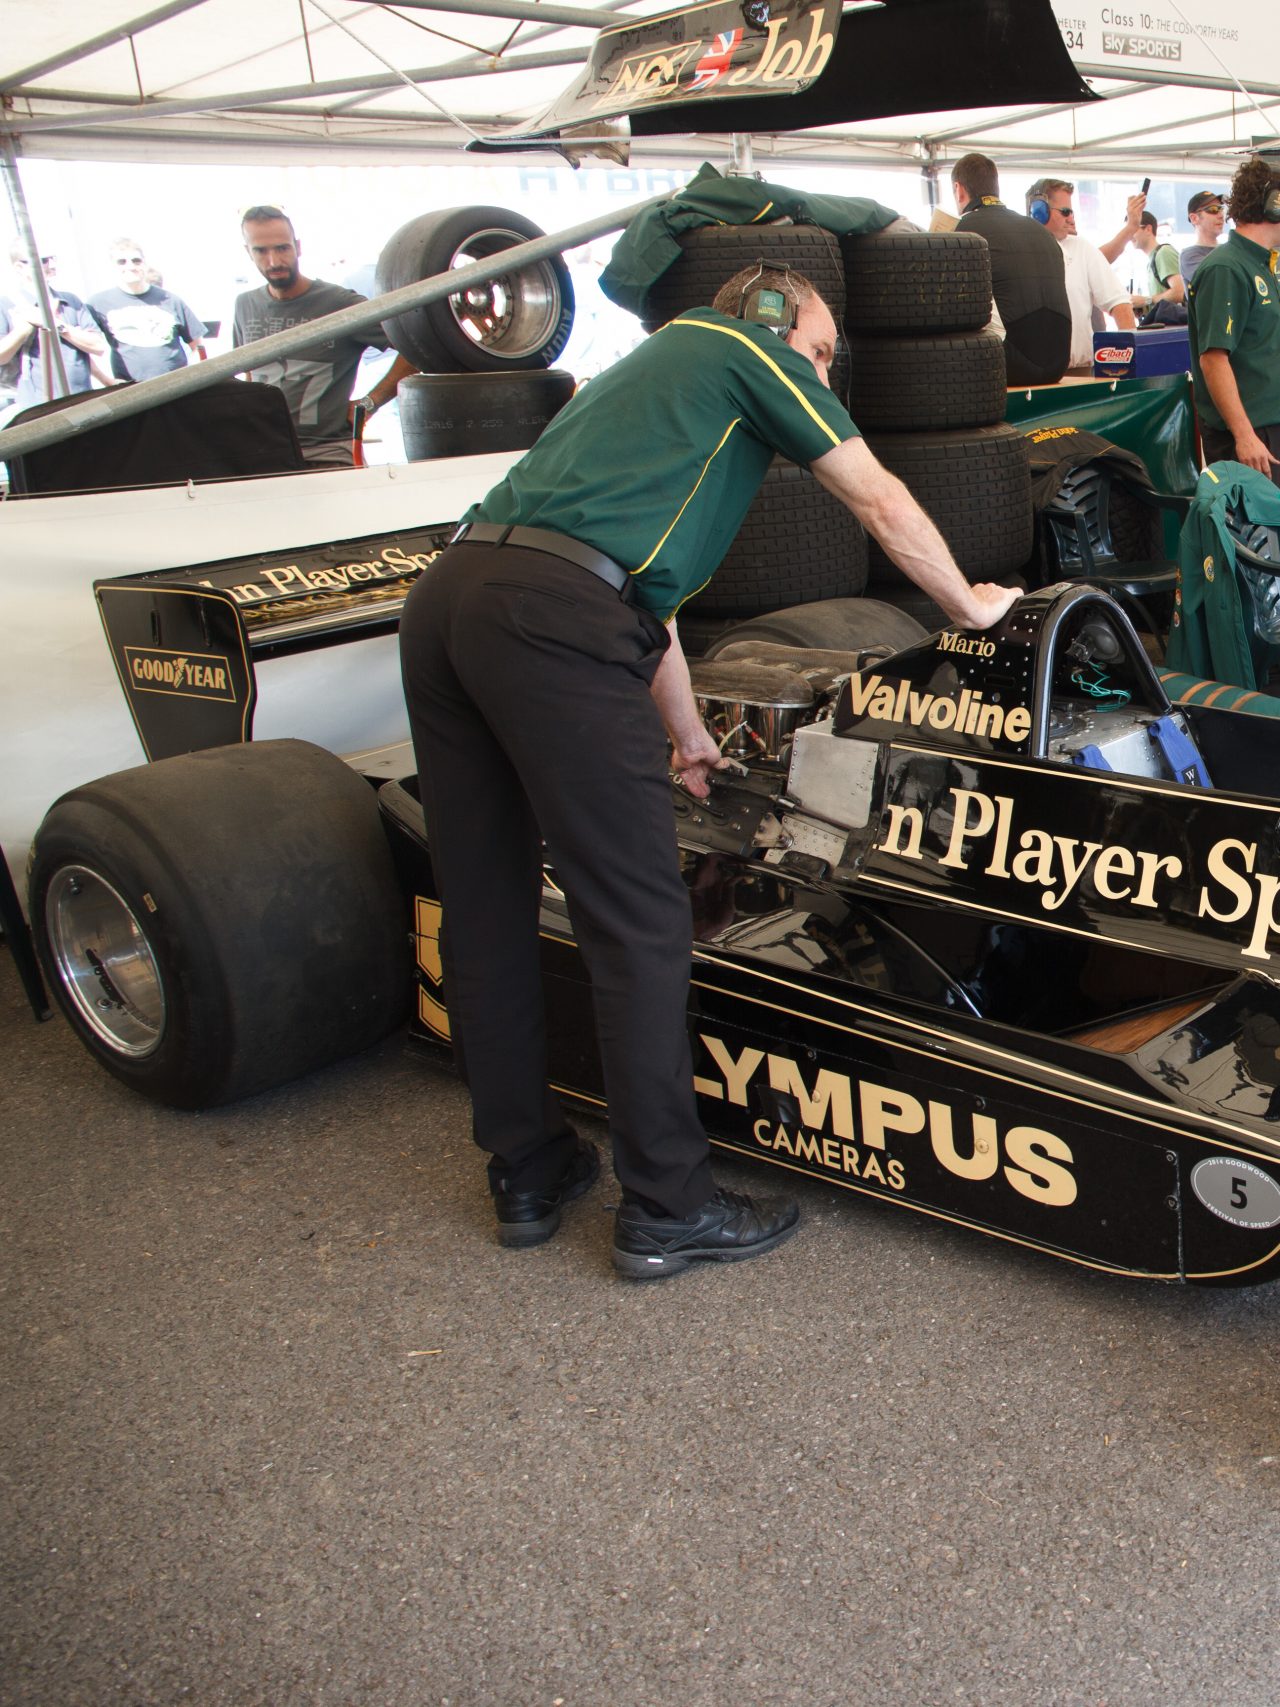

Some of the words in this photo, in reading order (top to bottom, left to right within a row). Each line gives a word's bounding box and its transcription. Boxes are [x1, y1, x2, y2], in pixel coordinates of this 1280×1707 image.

[1057, 18, 1087, 30] HELTER
[1060, 31, 1084, 50] 34
[1101, 8, 1135, 28] Class
[1156, 19, 1171, 31] THE
[1219, 27, 1239, 41] YEARS
[1104, 34, 1126, 55] sky
[1129, 38, 1180, 58] SPORTS
[607, 46, 691, 97] NGK
[1095, 348, 1132, 362] Eibach
[260, 559, 387, 596] Player
[936, 631, 996, 658] Mario
[132, 656, 227, 690] GOODYEAR
[850, 672, 1032, 743] Valvoline
[877, 804, 925, 862] n
[937, 787, 1182, 911] Player
[752, 1119, 906, 1191] CAMERAS
[1225, 1159, 1270, 1183] GOODWOOD
[1230, 1176, 1248, 1210] 5
[1206, 1203, 1238, 1225] FESTIVAL
